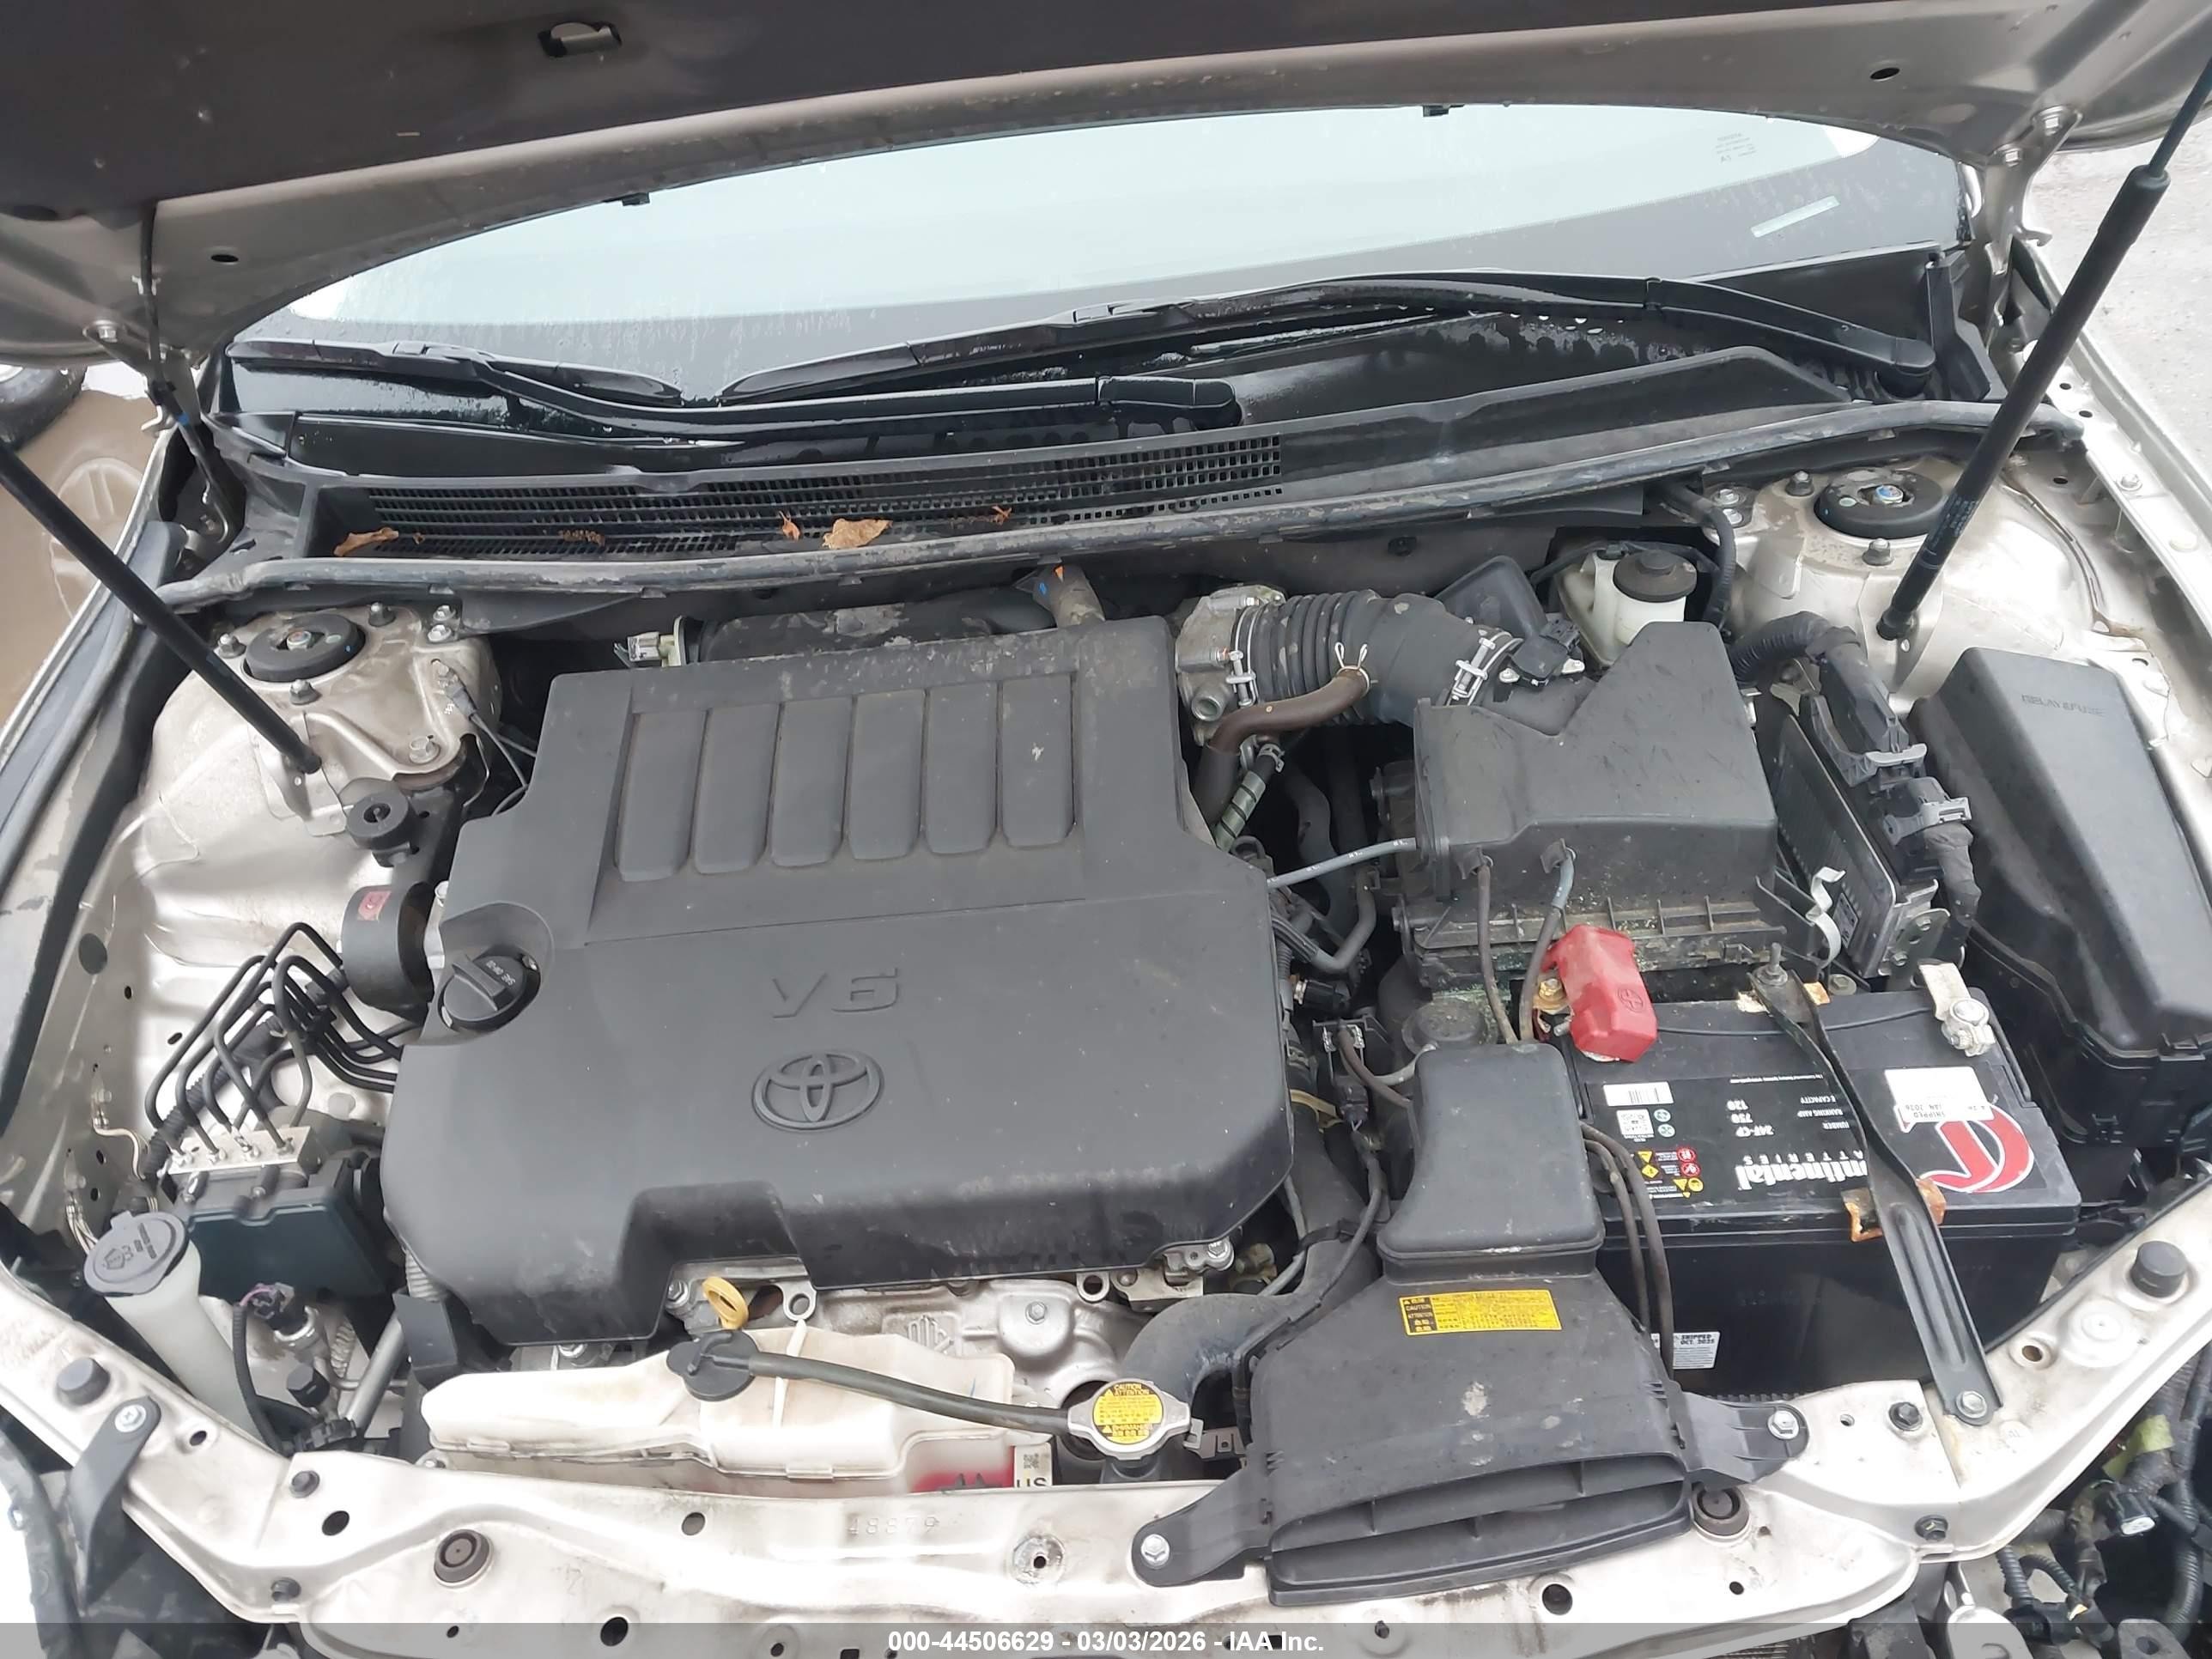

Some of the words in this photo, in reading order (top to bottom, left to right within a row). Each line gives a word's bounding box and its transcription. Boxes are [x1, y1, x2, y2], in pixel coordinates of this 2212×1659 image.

[771, 968, 900, 1018] V6
[1813, 1108, 1844, 1117] RANKING
[1743, 1150, 1863, 1165] ATTERIES
